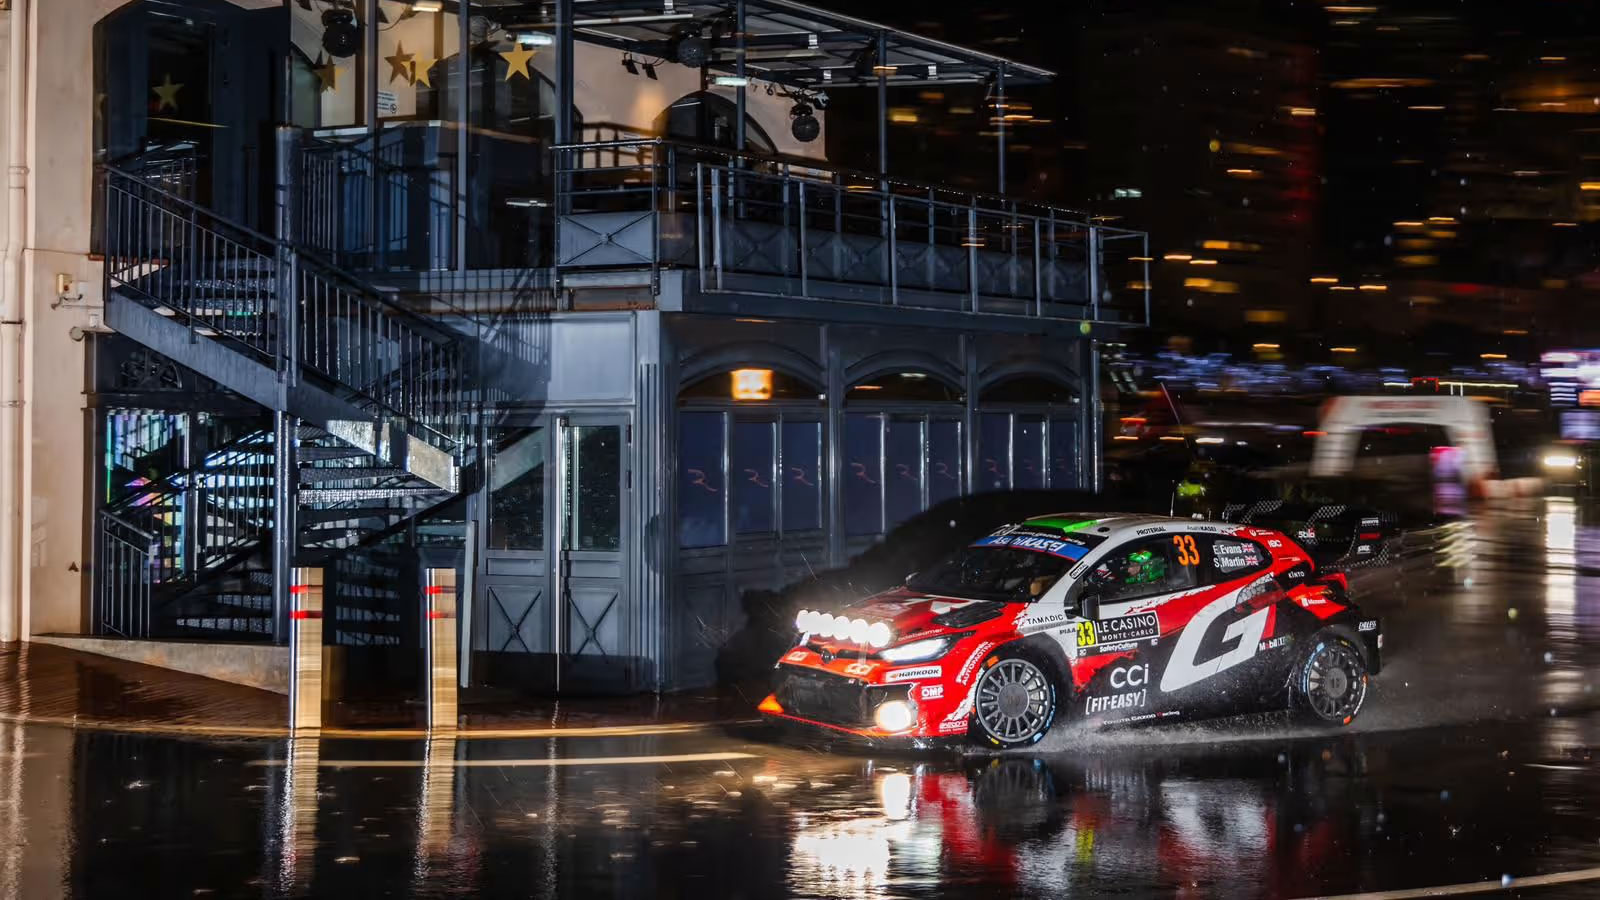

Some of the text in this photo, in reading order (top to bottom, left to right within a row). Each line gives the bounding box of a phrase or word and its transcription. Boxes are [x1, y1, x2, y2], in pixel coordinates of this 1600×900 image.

[1136, 526, 1166, 536] PROTERIAL
[1173, 535, 1200, 566] 33
[1213, 556, 1246, 568] S.Martin
[1027, 614, 1064, 625] TAMADIC
[1096, 614, 1156, 634] LE CASINO
[1059, 627, 1076, 635] PIAA
[1076, 621, 1095, 647] 33
[1099, 641, 1138, 653] SafetyCulture
[921, 686, 944, 697] OMP
